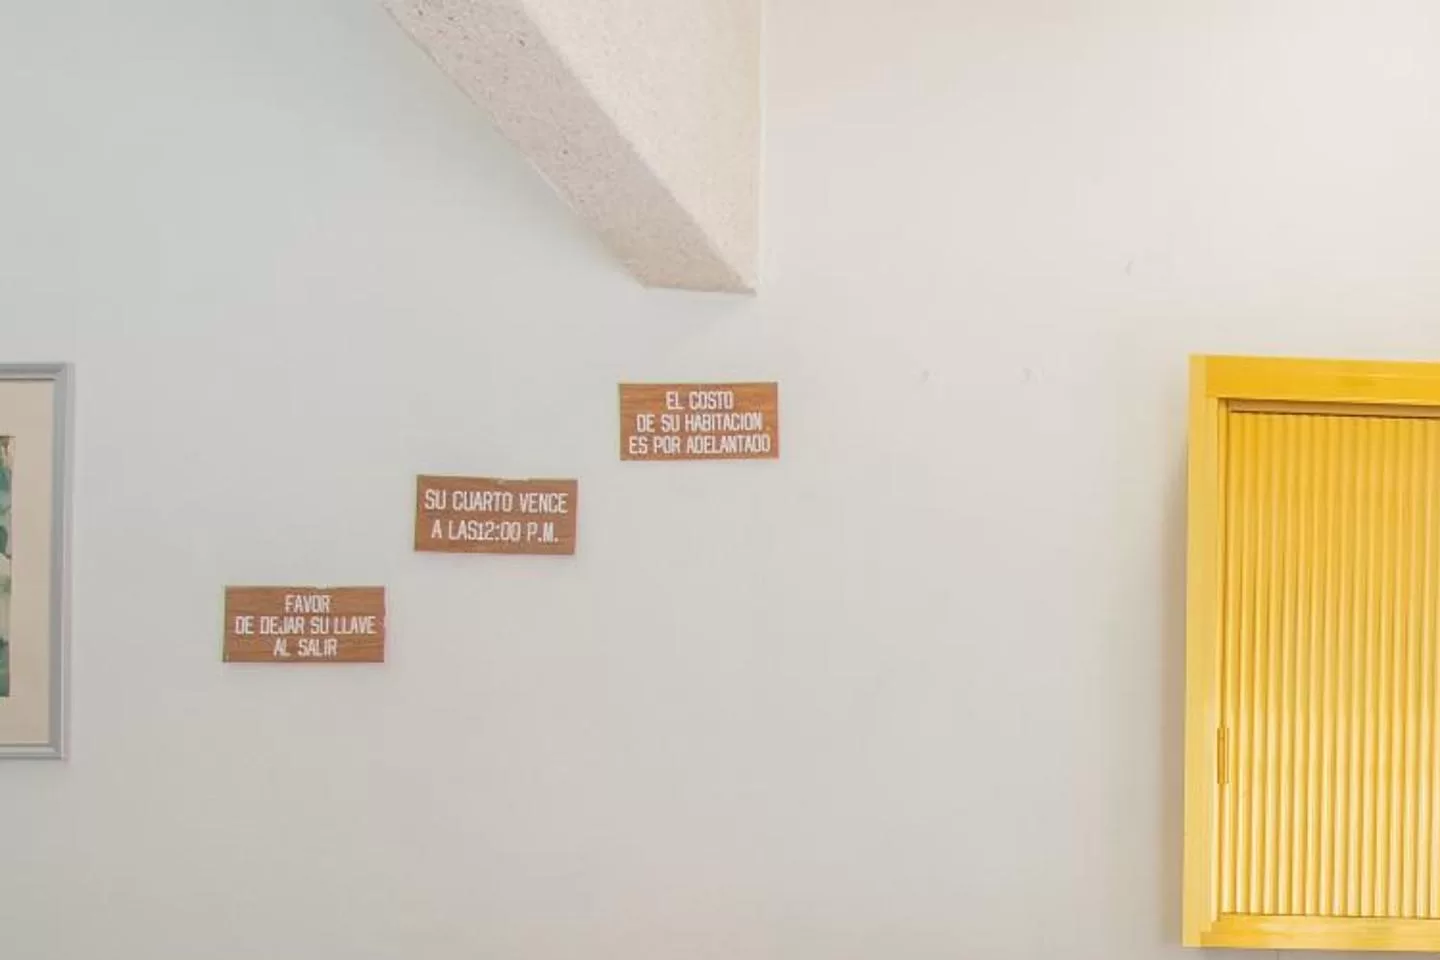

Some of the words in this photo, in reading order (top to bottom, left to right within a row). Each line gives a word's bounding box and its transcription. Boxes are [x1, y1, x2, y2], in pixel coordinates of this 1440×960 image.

[666, 391, 684, 410] EL
[689, 391, 734, 410] COSTO
[636, 414, 655, 433] DE
[661, 414, 681, 432] SU
[685, 412, 763, 432] HABITACION
[628, 436, 648, 454] ES
[653, 435, 681, 454] POR
[686, 434, 771, 453] ADELANTADO
[424, 489, 446, 510] SU
[452, 490, 513, 512] CUARTO
[519, 492, 569, 513] VENCE
[431, 519, 443, 539] A
[527, 521, 559, 543] P.M.
[284, 594, 332, 613] FAVOR
[235, 615, 254, 635] DE
[260, 615, 305, 635] DEJAR
[310, 615, 329, 635] SU
[334, 615, 377, 635] LLAVE
[273, 638, 292, 657] AL
[297, 638, 337, 657] SALIR
